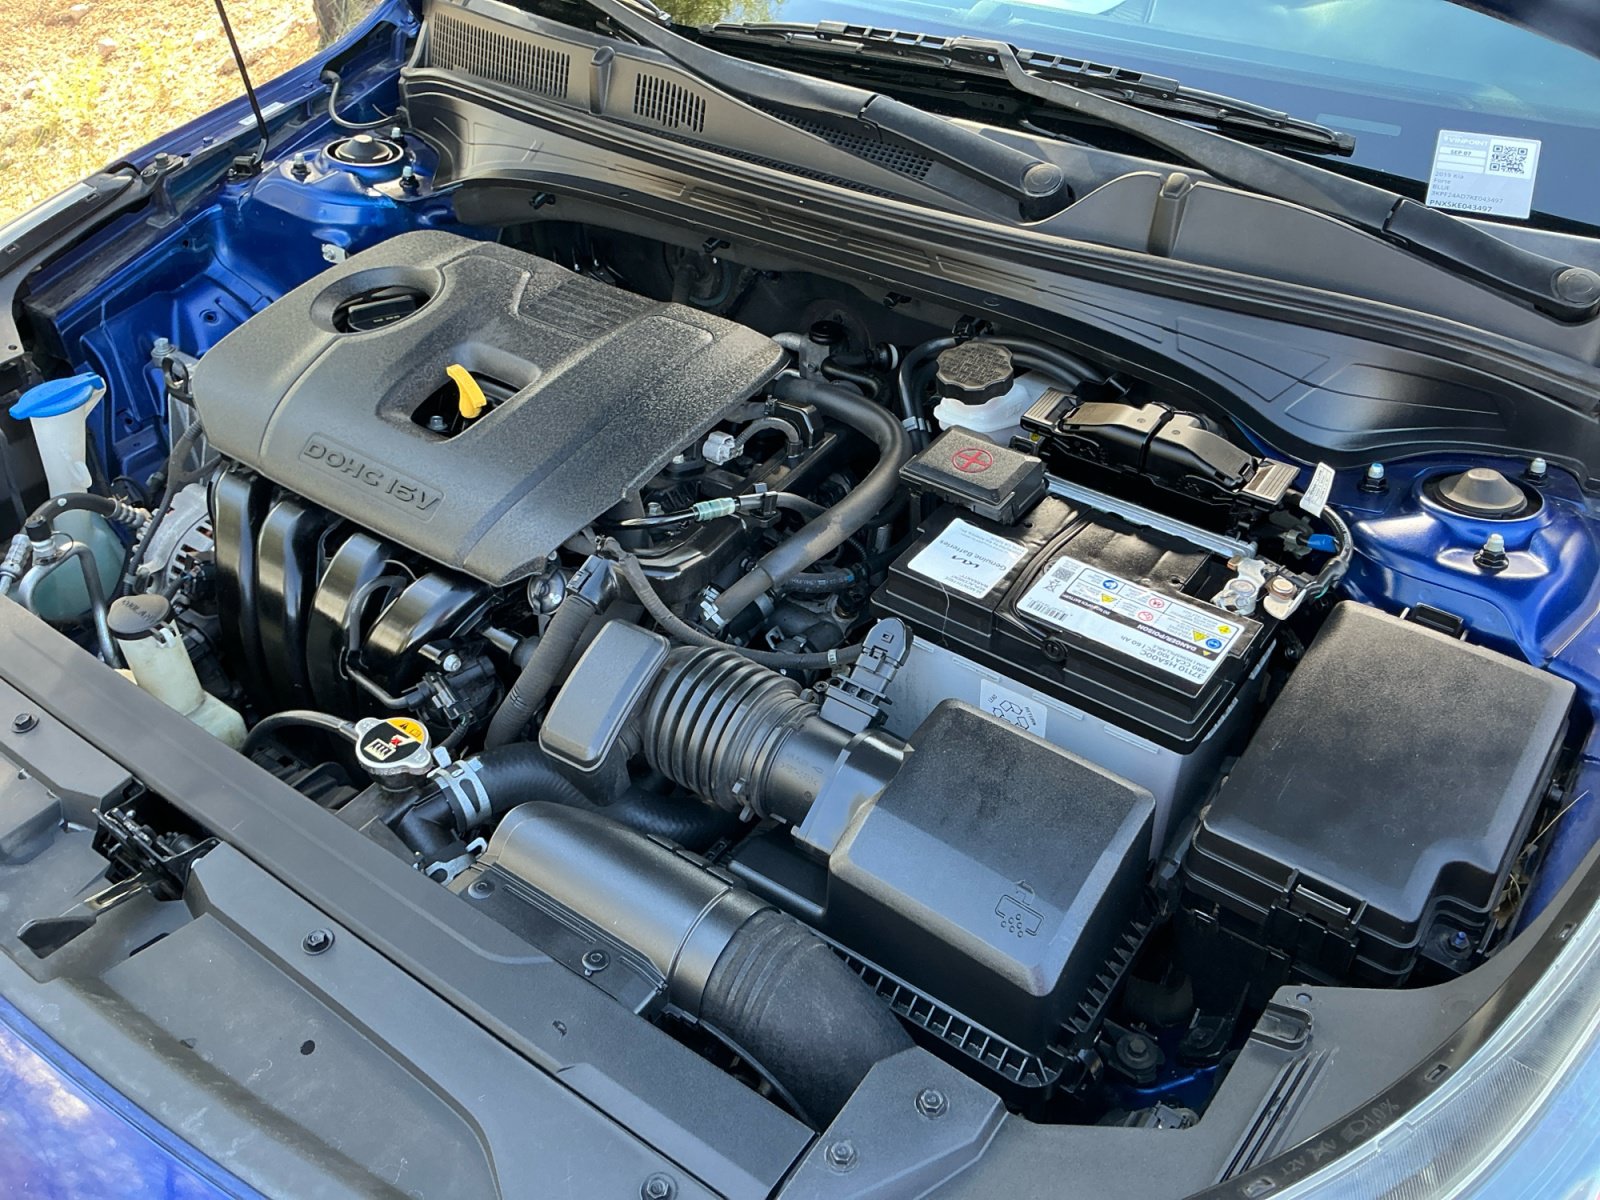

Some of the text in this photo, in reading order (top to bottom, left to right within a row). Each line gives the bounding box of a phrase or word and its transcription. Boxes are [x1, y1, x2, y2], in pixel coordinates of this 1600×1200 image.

[303, 443, 441, 511] DOHC 16V
[939, 539, 973, 557] Batteries
[973, 553, 1007, 571] Genuine
[1129, 639, 1142, 647] 60
[1136, 623, 1197, 651] DANGER/POISON
[1145, 645, 1157, 653] RC
[1156, 650, 1171, 659] 100
[1174, 657, 1191, 667] CCA
[1176, 664, 1204, 679] 37110
[1191, 664, 1208, 674] 680
